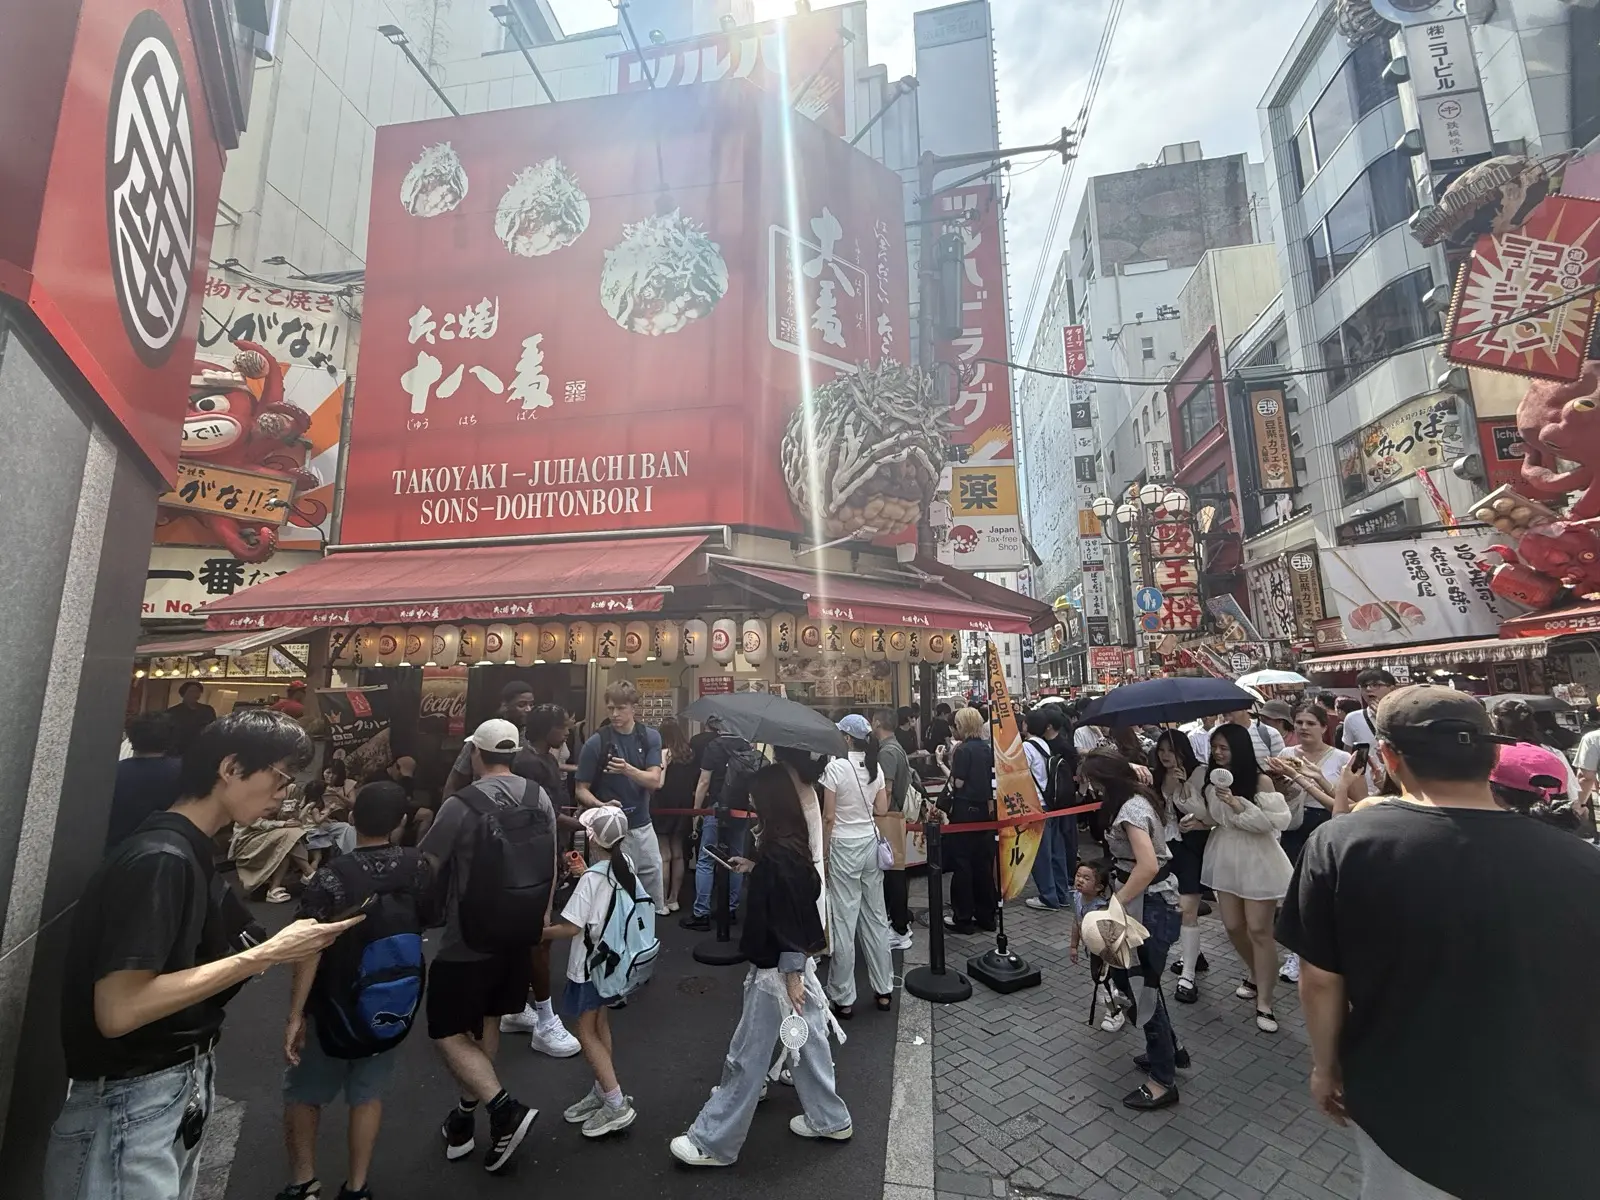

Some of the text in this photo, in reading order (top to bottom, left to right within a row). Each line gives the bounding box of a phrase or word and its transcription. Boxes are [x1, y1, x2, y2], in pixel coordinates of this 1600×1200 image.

[406, 417, 429, 431] じゅう
[458, 414, 477, 426] はち
[516, 408, 538, 421] ばん
[1265, 419, 1282, 462] 豆柴カフェ
[1378, 411, 1447, 457] みつば
[959, 473, 999, 510] 薬
[986, 535, 1018, 543] Tax-free
[998, 543, 1019, 552] Shop
[147, 558, 245, 595] 一番
[1402, 549, 1437, 597] 居酒屋
[989, 650, 1000, 676] VERY
